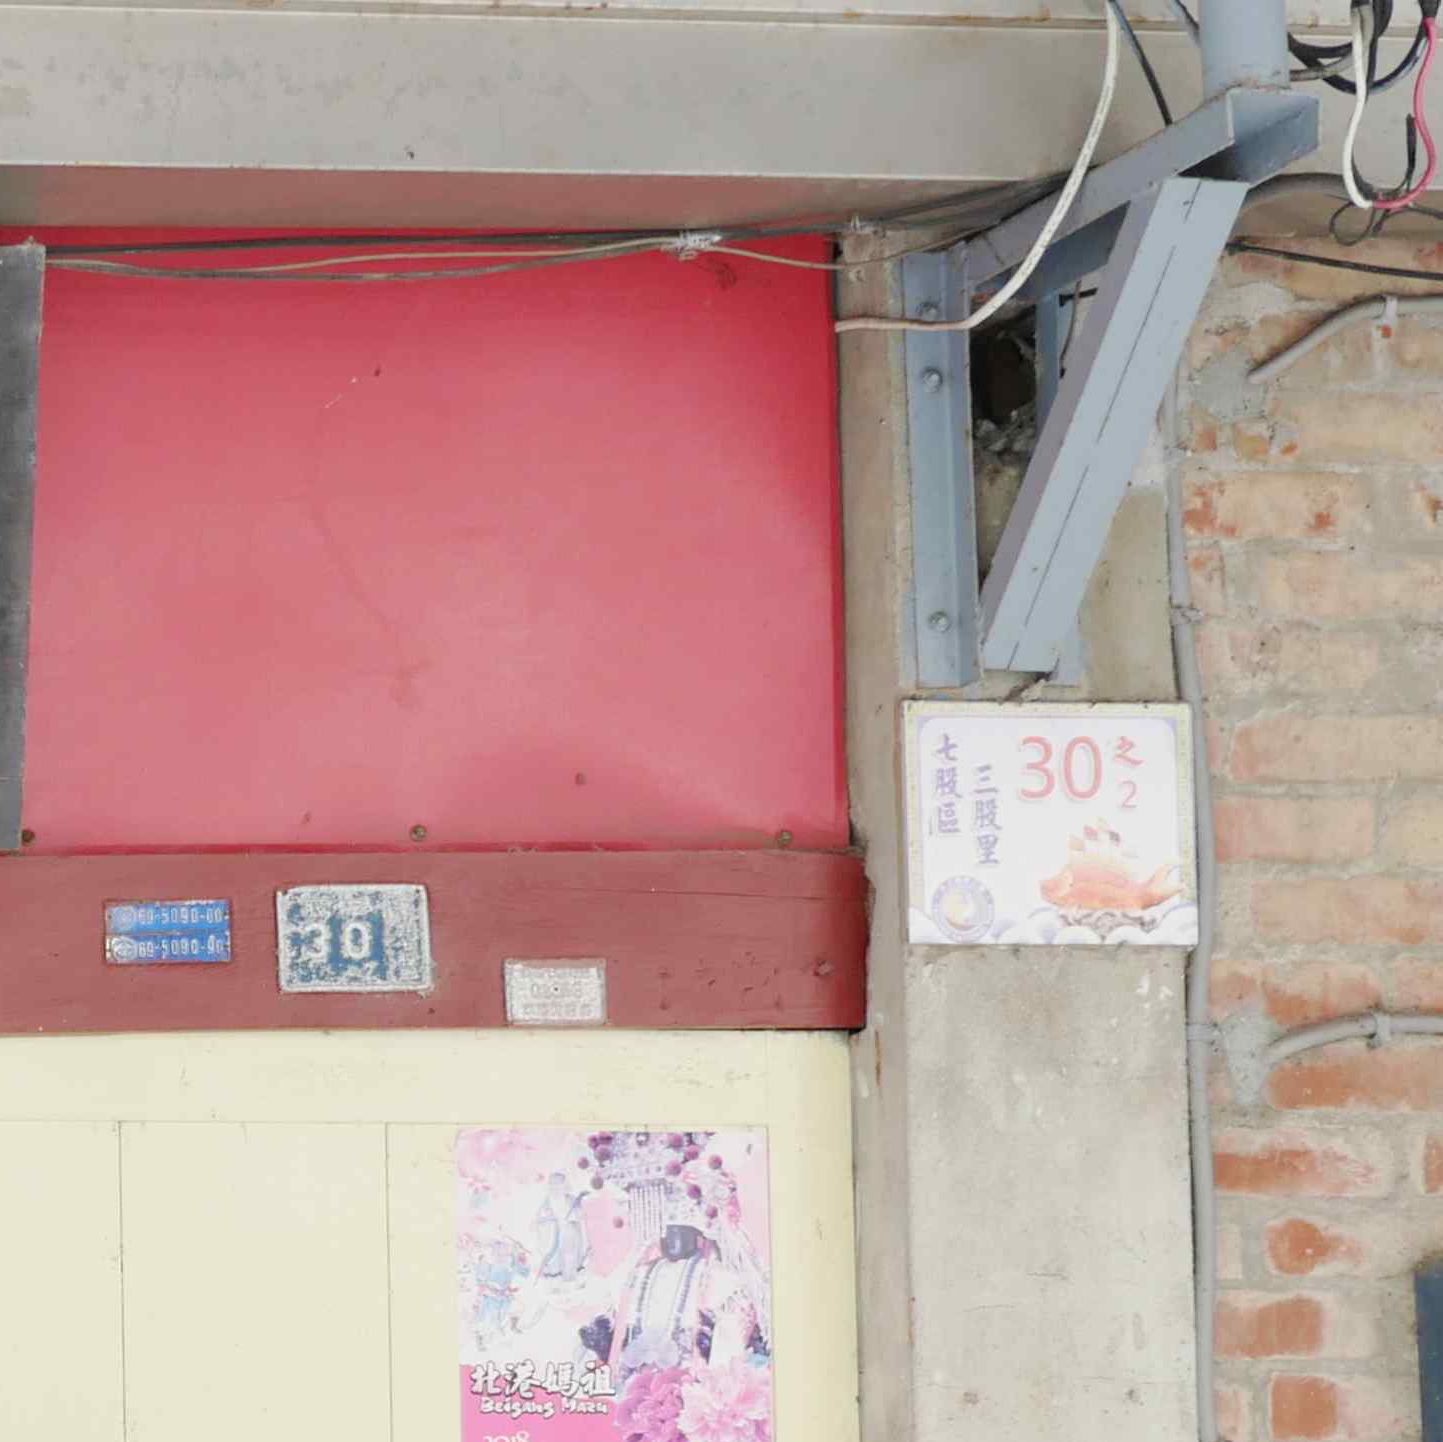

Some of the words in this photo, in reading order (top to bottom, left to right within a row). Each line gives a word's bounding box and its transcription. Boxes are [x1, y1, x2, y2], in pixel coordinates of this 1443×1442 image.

[1018, 735, 1103, 800] 30
[973, 764, 1002, 865] 三股里
[470, 1360, 616, 1400] 北港媽祖
